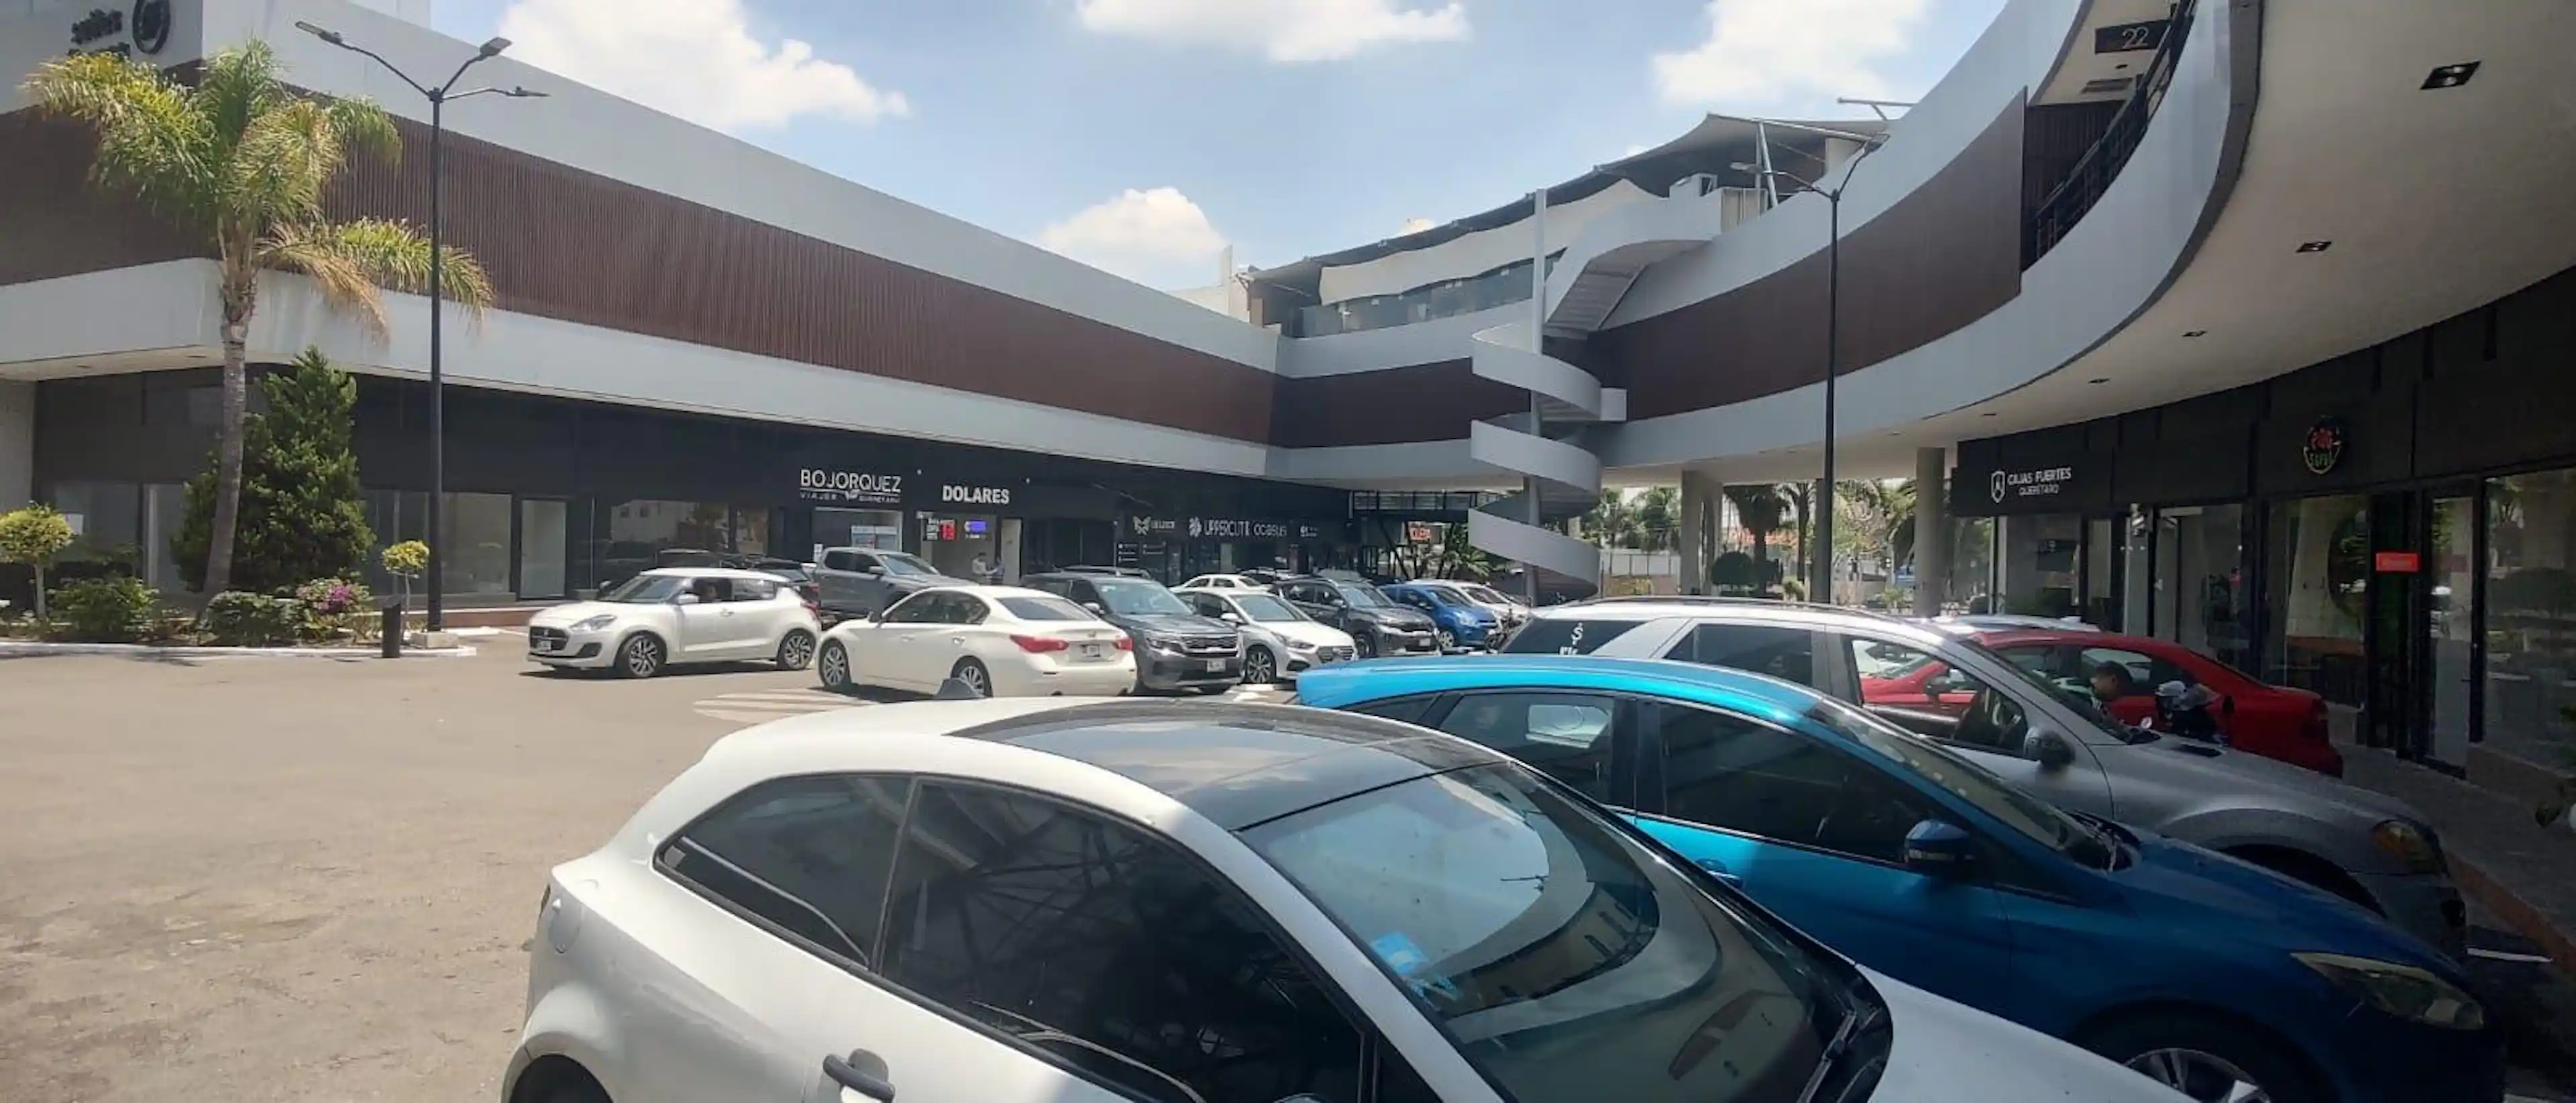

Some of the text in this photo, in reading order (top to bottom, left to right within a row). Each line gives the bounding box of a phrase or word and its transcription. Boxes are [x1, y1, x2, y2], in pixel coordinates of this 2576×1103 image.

[2122, 26, 2149, 49] 22
[800, 469, 902, 493] BOJORQUEZ
[942, 484, 1010, 505] DOLARES
